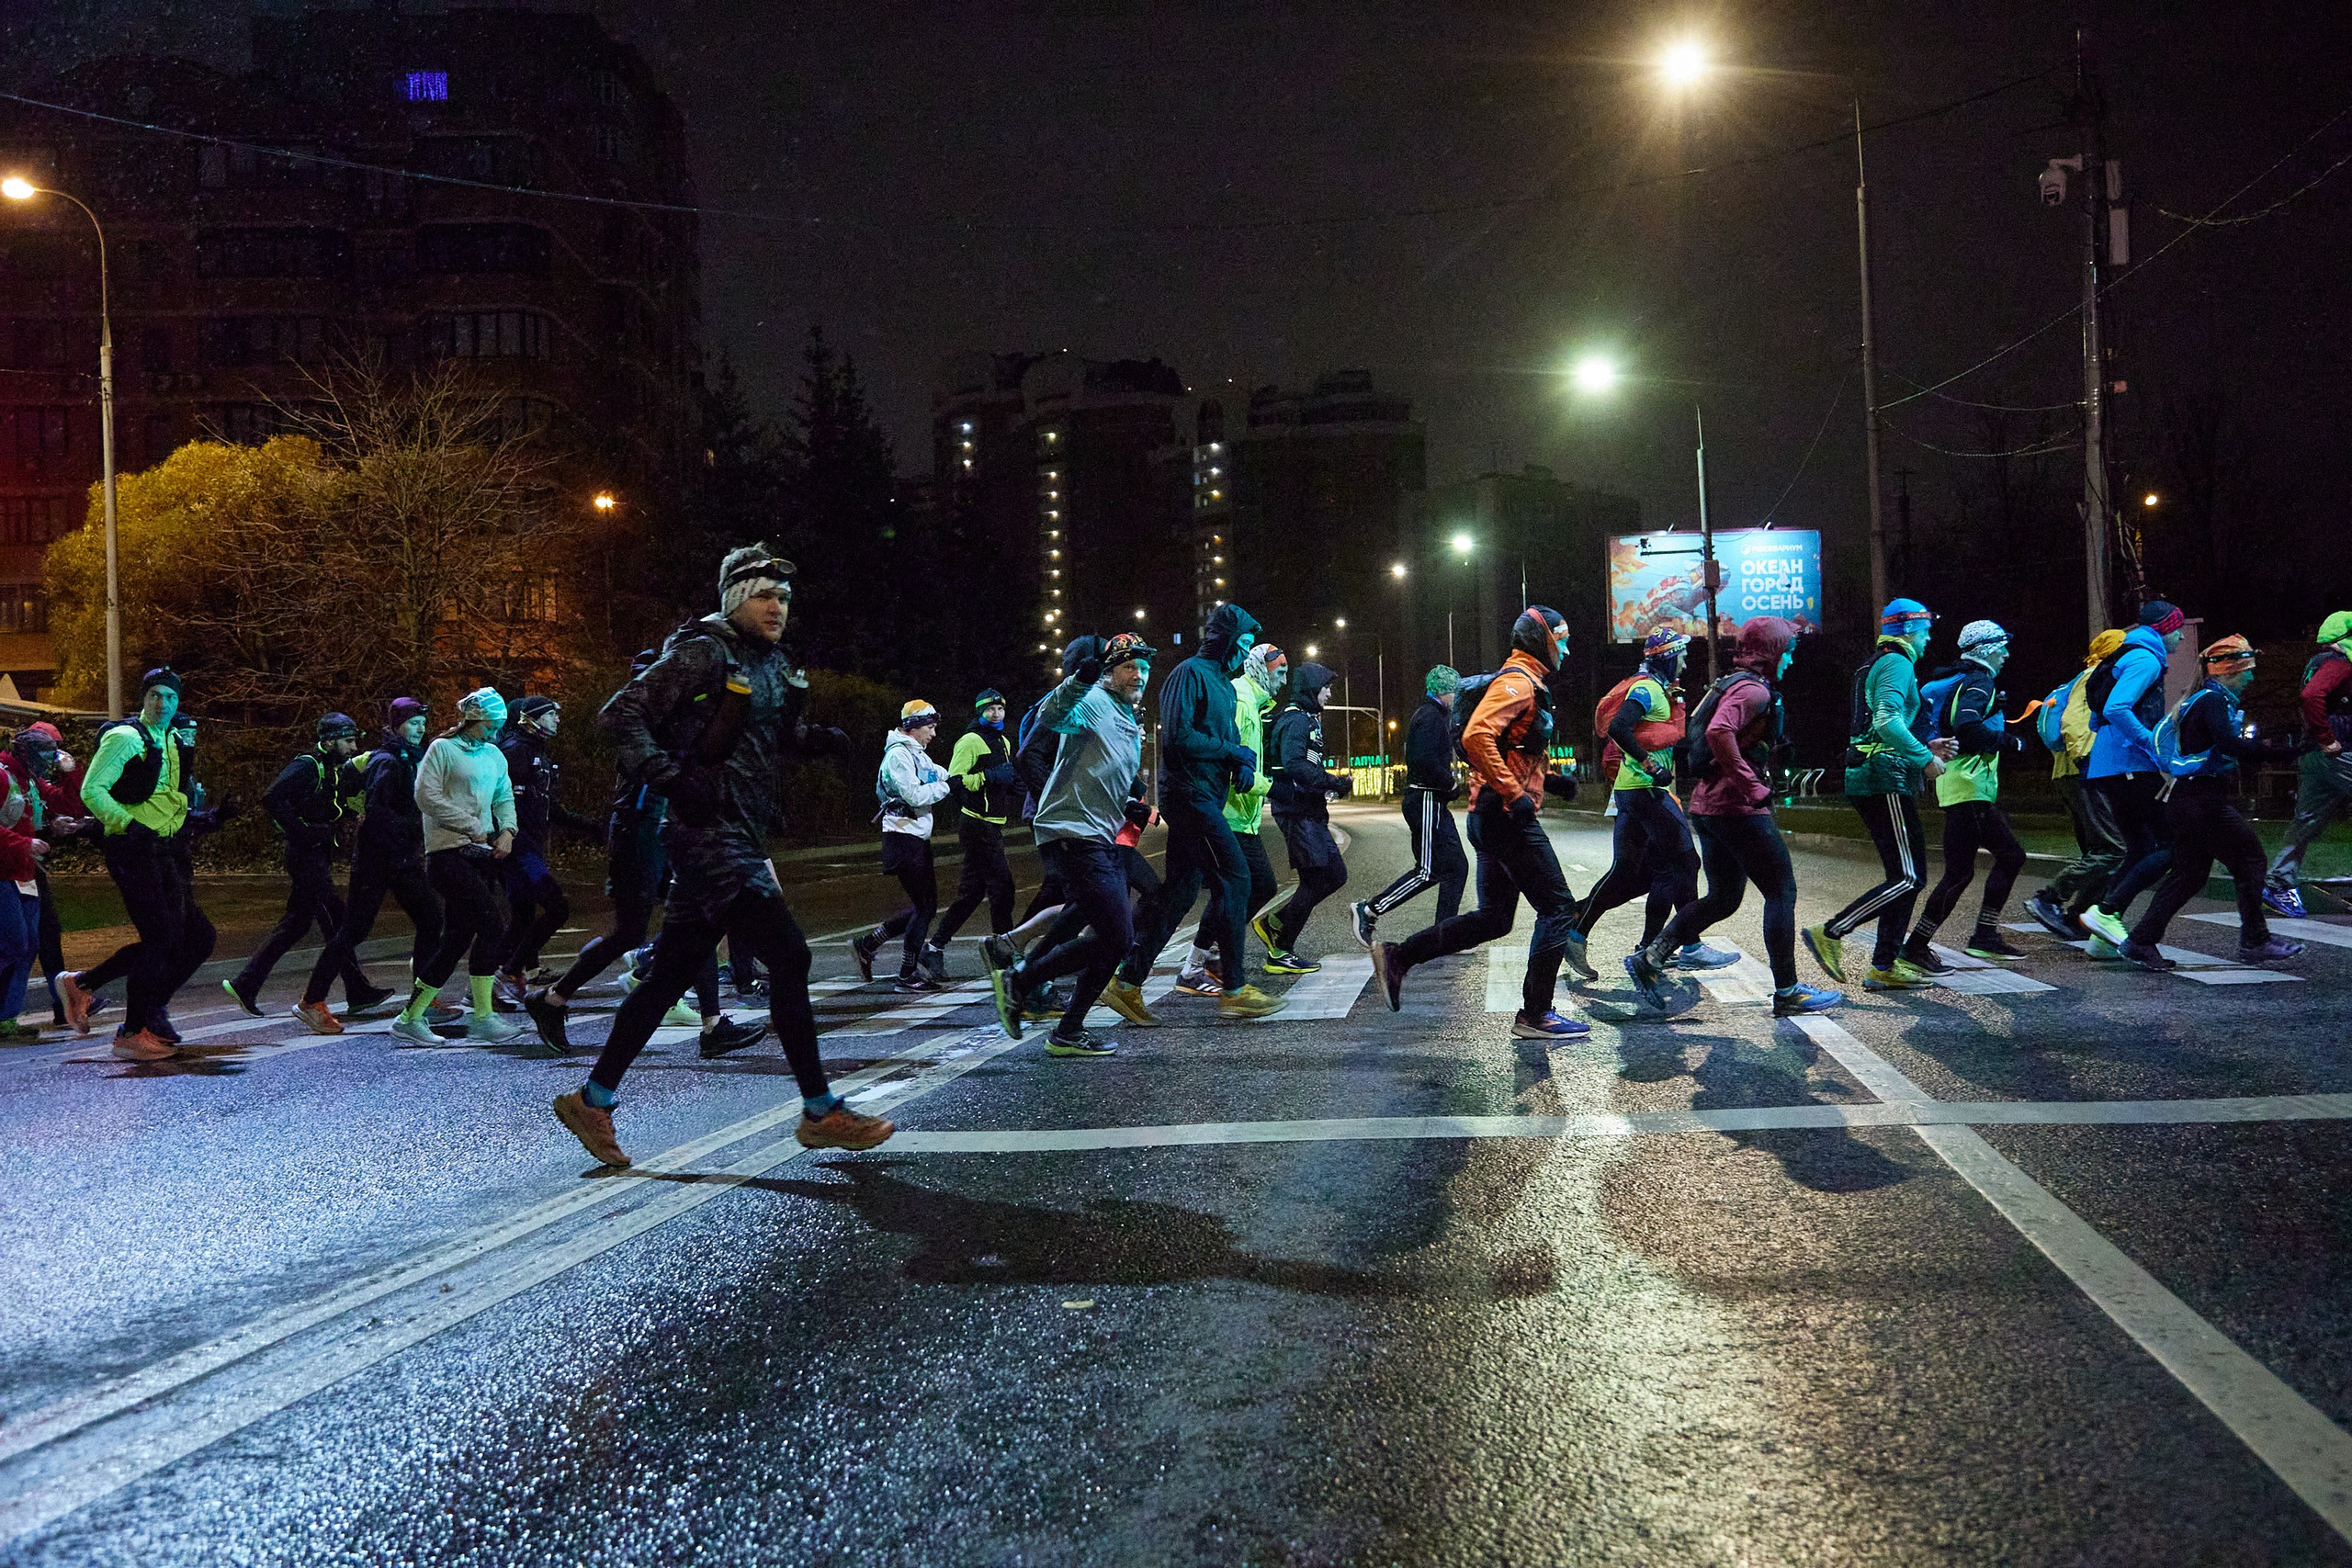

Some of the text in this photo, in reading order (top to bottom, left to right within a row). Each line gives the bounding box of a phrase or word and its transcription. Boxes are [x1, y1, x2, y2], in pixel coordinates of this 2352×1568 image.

[1741, 558, 1803, 575] ОКЕАН
[1741, 576, 1804, 594] ГОРОД
[1741, 593, 1804, 611] ОСЕНЬ
